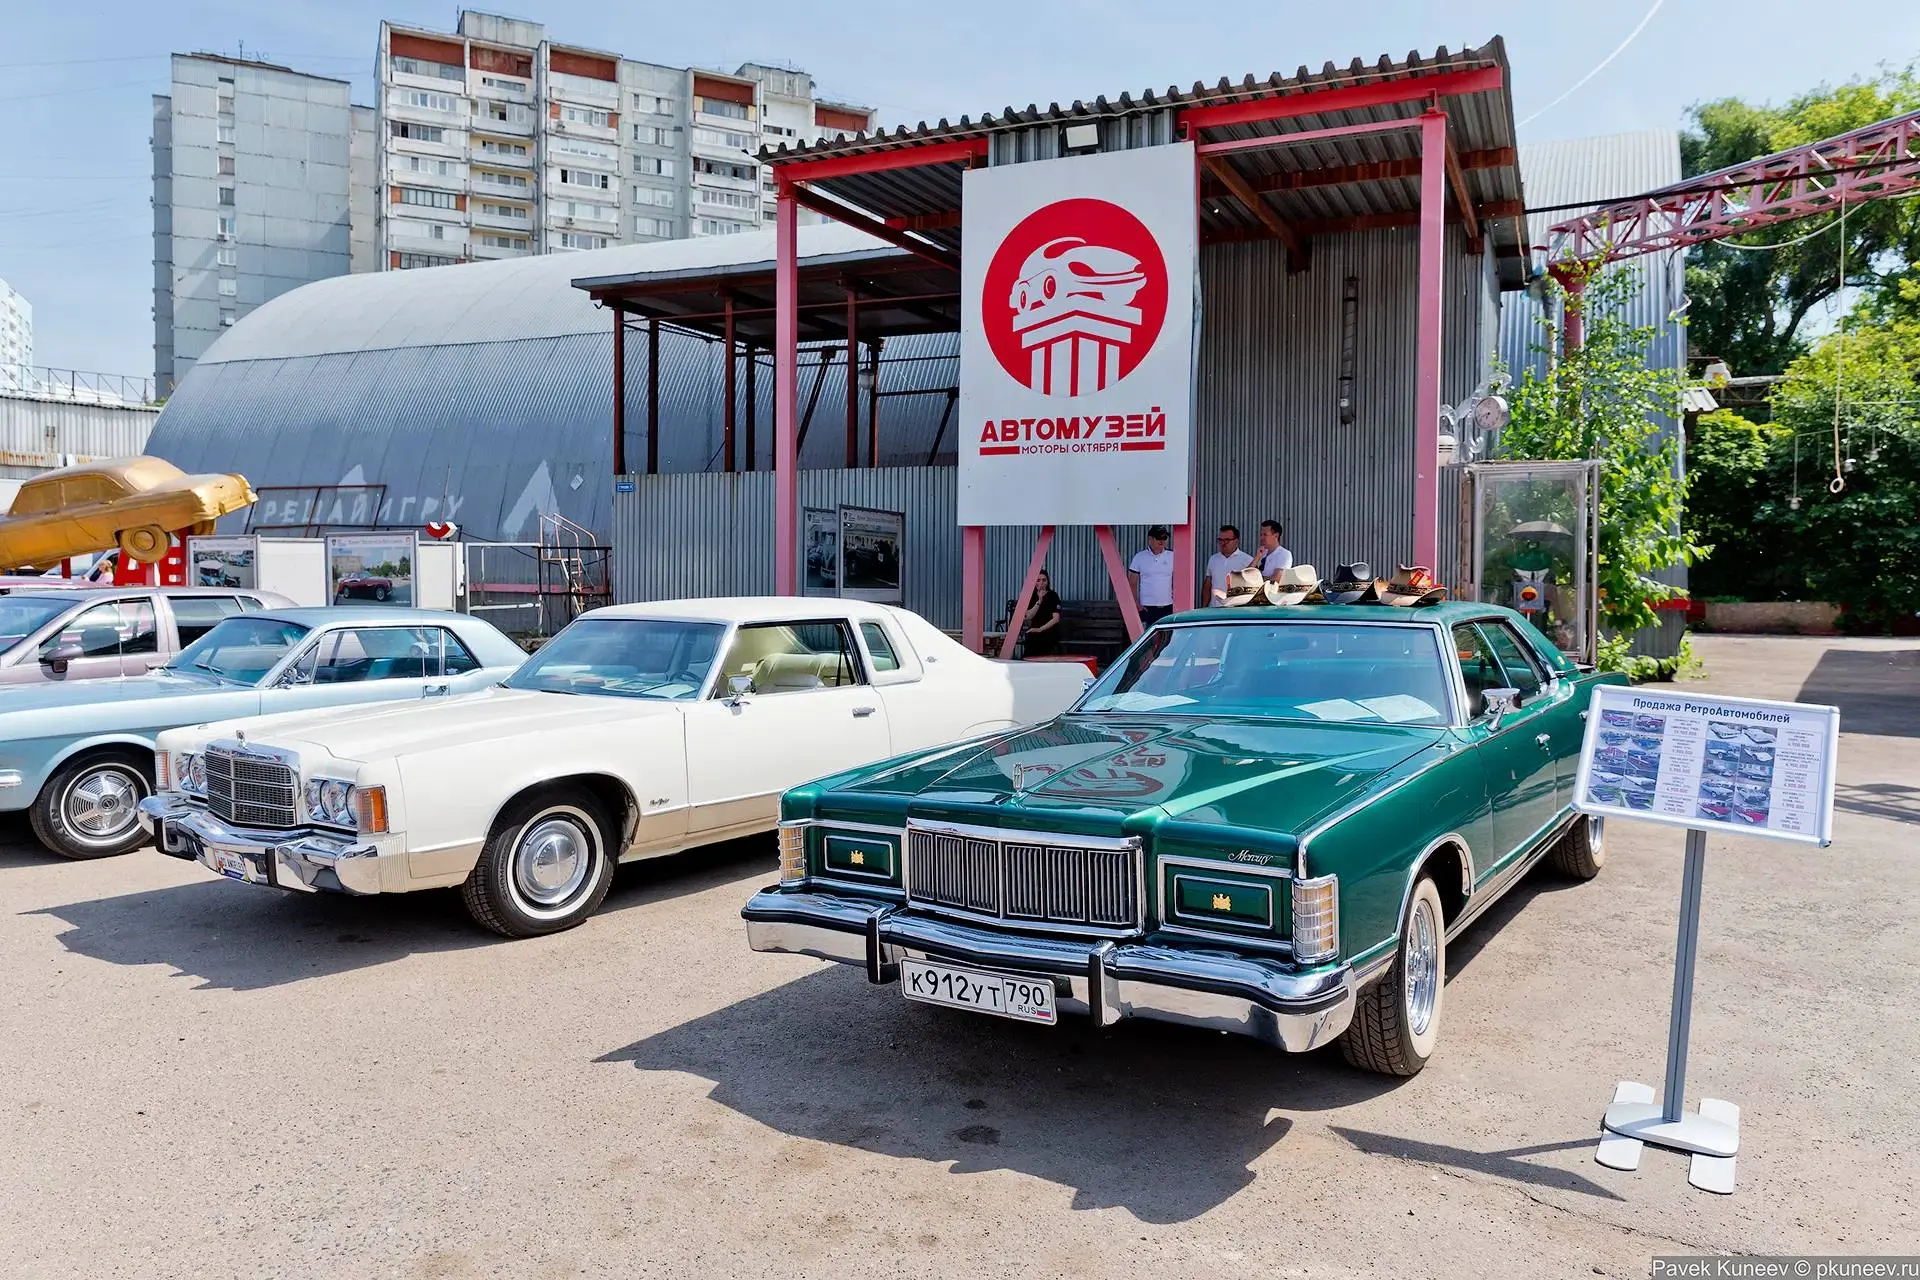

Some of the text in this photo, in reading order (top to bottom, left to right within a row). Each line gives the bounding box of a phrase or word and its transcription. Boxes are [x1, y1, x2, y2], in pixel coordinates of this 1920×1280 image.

[979, 406, 1166, 442] АВТОМУЗЕЙ
[1021, 442, 1119, 455] МОТОРЫ ОКТЯБРЯ
[1633, 697, 1791, 724] Продажа РетроАвтомобилей
[1005, 981, 1045, 1007] 790
[1017, 1004, 1037, 1015] RUS
